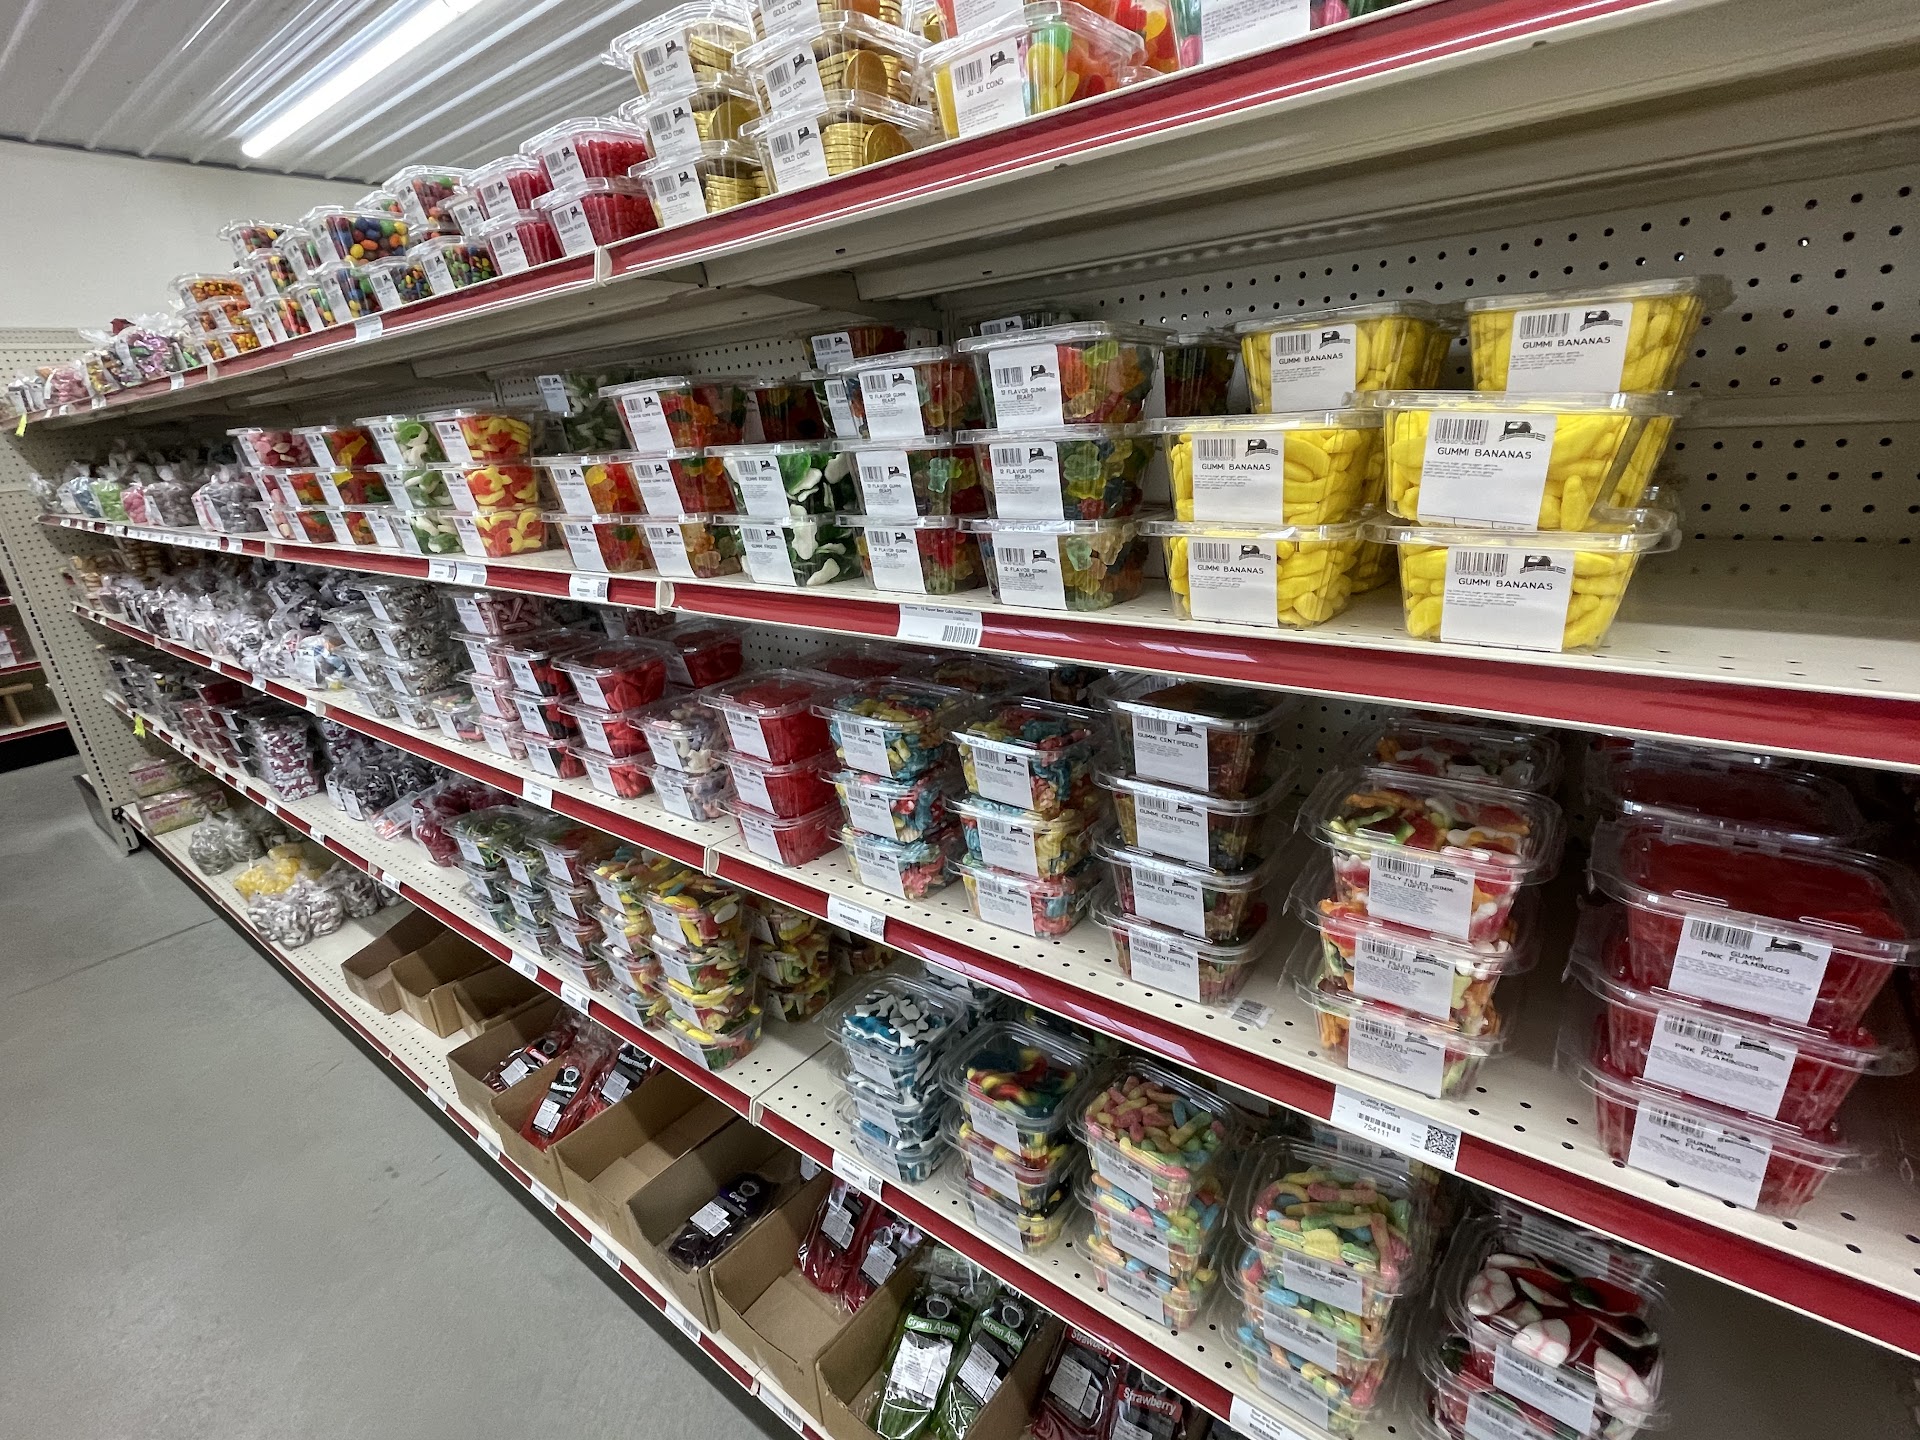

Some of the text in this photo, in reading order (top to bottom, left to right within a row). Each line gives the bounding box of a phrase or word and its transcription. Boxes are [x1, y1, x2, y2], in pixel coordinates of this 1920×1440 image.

[986, 78, 1004, 90] COINS
[1523, 337, 1611, 349] GUMMI BANANAS
[1279, 353, 1344, 365] GUMMI BANANAS
[1438, 447, 1532, 460] GUMMI BANANAS
[1224, 566, 1264, 575] BANANAS
[1458, 578, 1553, 591] GUMMI BANANAS
[1138, 732, 1199, 749] GUMMI CENTIPEDES
[1140, 809, 1200, 827] GUMMI CENTIPEDES
[1137, 881, 1196, 900] GUMMI CENTIPEDES
[1404, 882, 1434, 893] TURTLES
[1406, 878, 1428, 887] FILLED
[1432, 884, 1454, 893] GUMMI
[1134, 946, 1191, 968] GUMMI CENTIPEDES
[1701, 950, 1790, 975] PINK FLAMINGOS
[1730, 951, 1763, 962] GUMMI
[1366, 955, 1436, 976] JELLY FILLED GUMMI
[1360, 1033, 1379, 1041] JELLY
[1675, 1042, 1759, 1072] PINK FLAMINGOS
[1702, 1046, 1734, 1058] GUMMI
[1366, 1098, 1396, 1112] Jelly Filled
[1382, 1109, 1400, 1120] Turtles
[1363, 1122, 1390, 1138] 754111
[1660, 1134, 1741, 1164] PINK FLAMINGOS
[1686, 1138, 1717, 1150] GUMMI
[907, 1316, 960, 1336] Green Apple
[983, 1317, 1023, 1350] Green Apple
[1123, 1387, 1177, 1416] Strawberry
